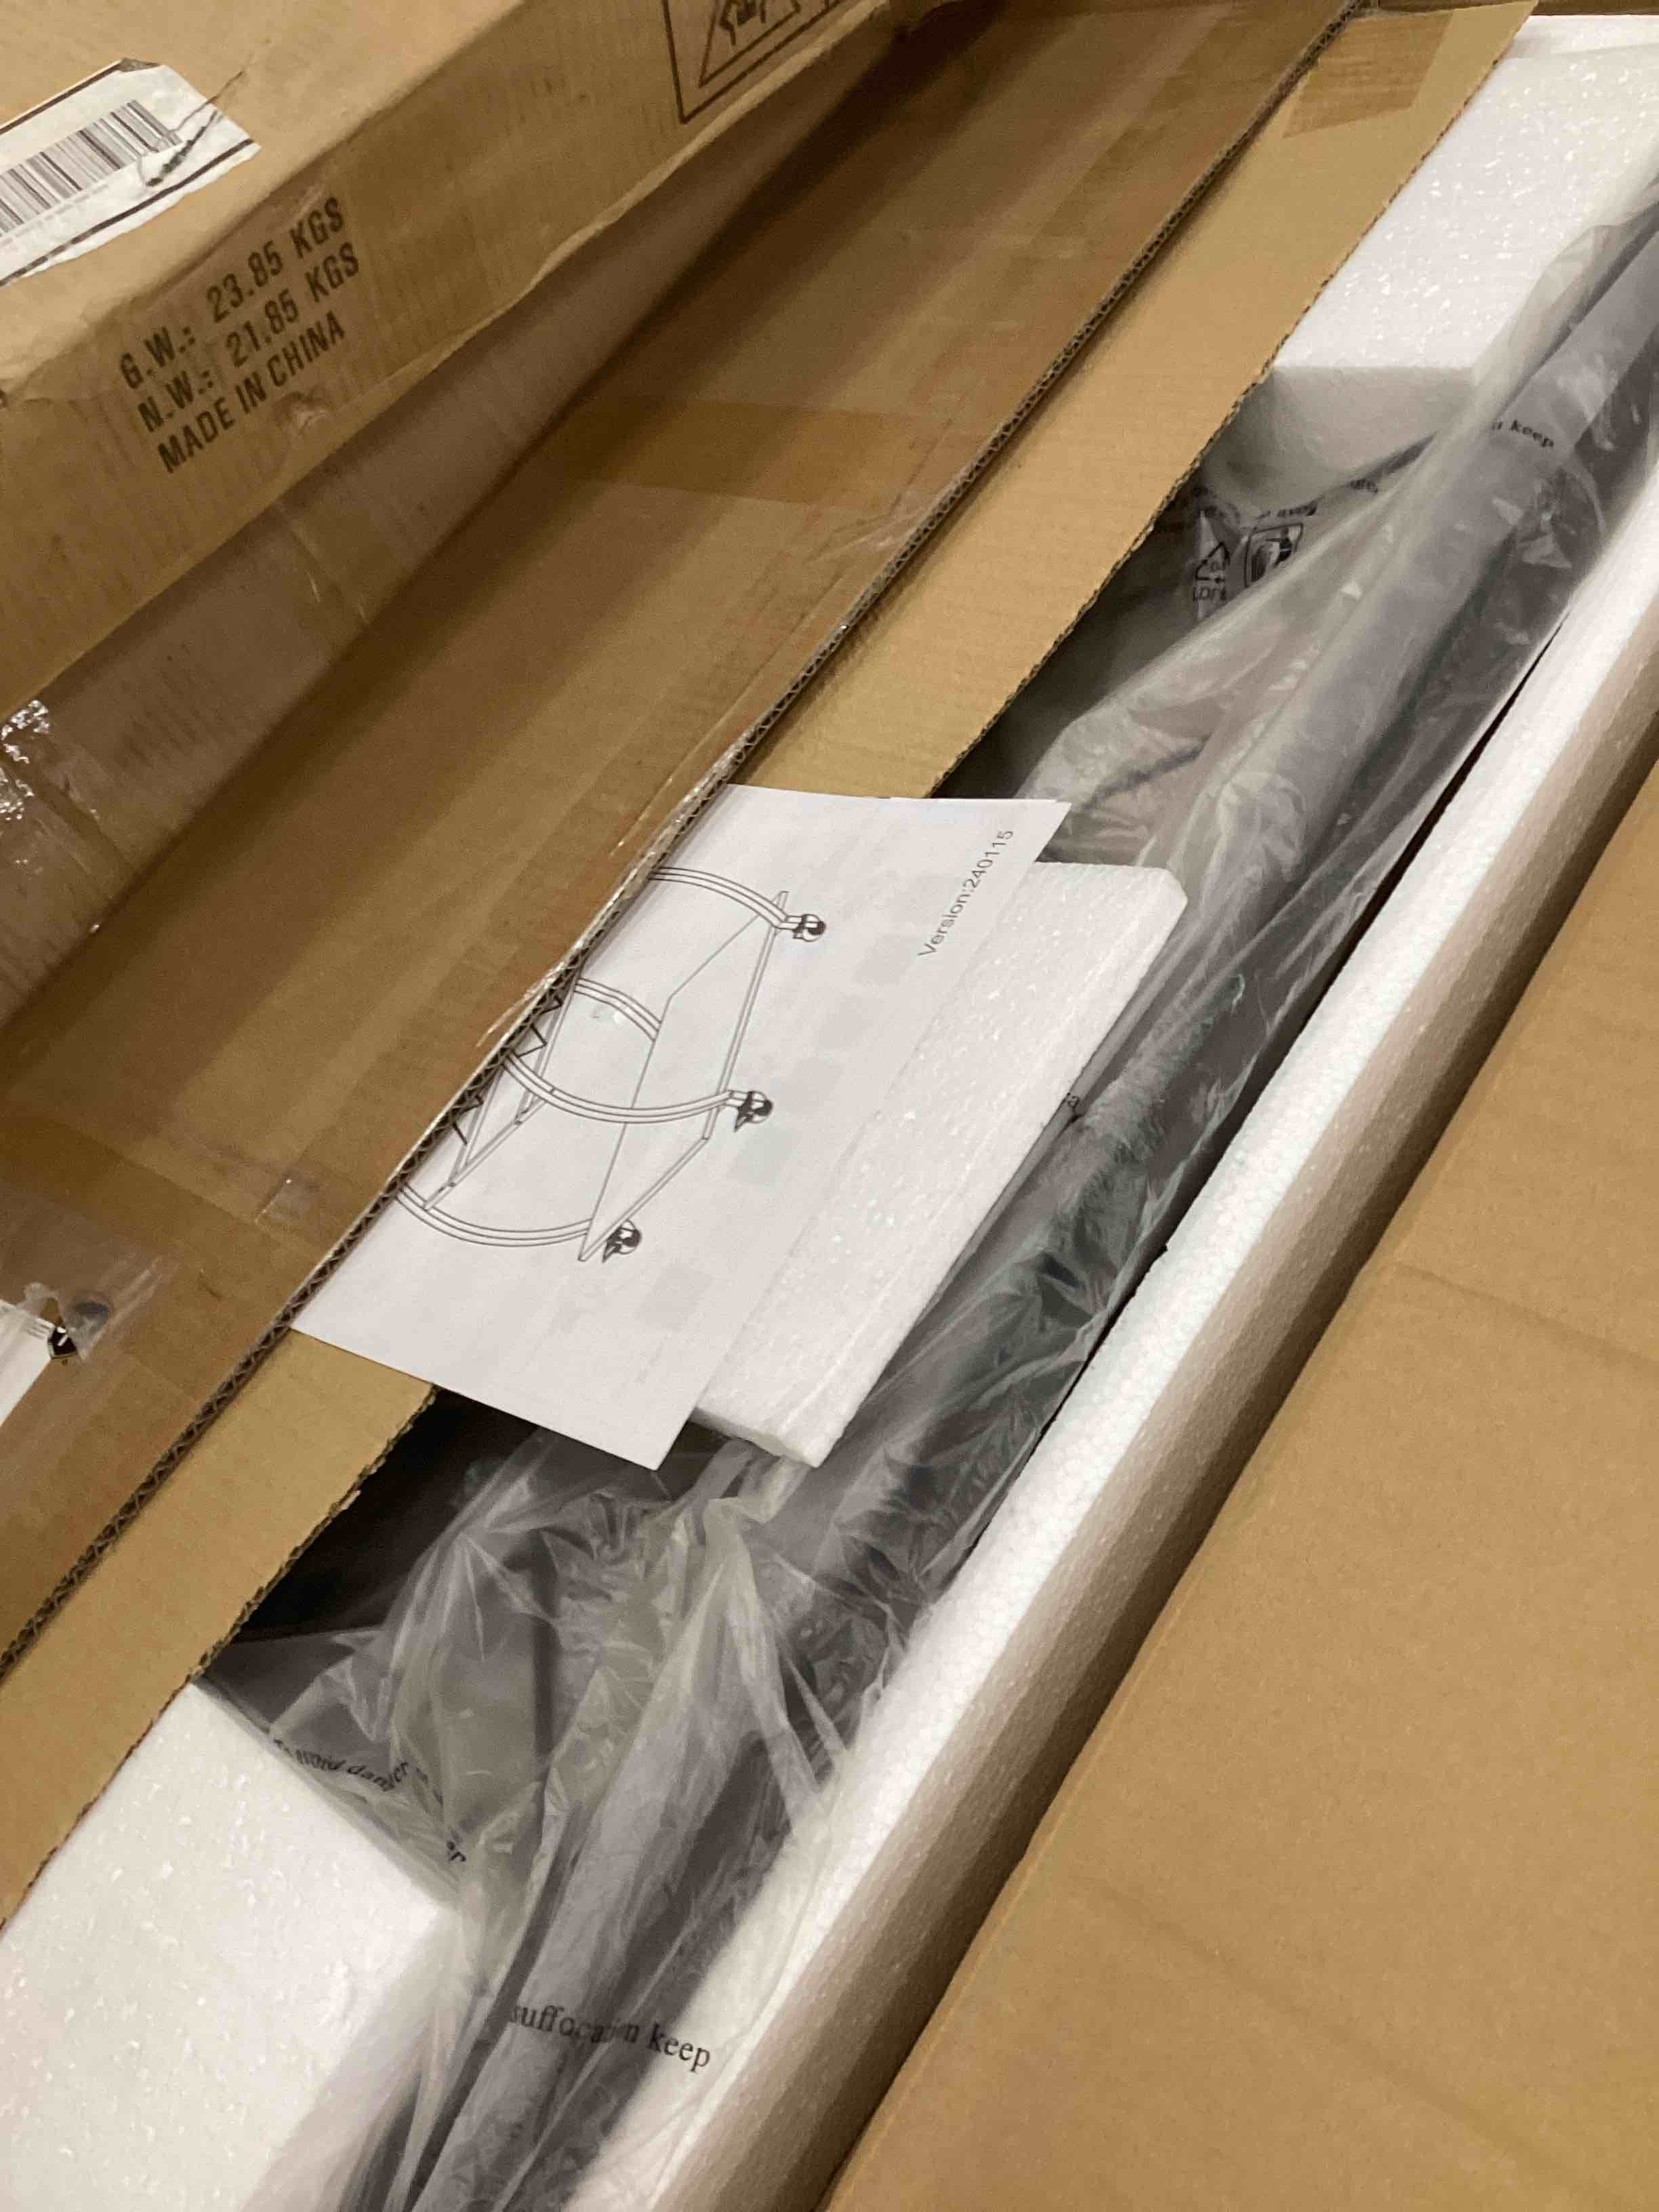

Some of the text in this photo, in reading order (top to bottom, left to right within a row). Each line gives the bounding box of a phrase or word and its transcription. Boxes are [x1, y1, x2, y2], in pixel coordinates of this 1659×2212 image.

[120, 197, 344, 390] G.W.: 23.85 KGS
[138, 242, 359, 433] N.W.: 21.85 KGS
[157, 310, 346, 474] MADE IN CHINA
[1509, 419, 1555, 449] keep
[917, 830, 1014, 956] Version:240115
[646, 2022, 711, 2072] keep
